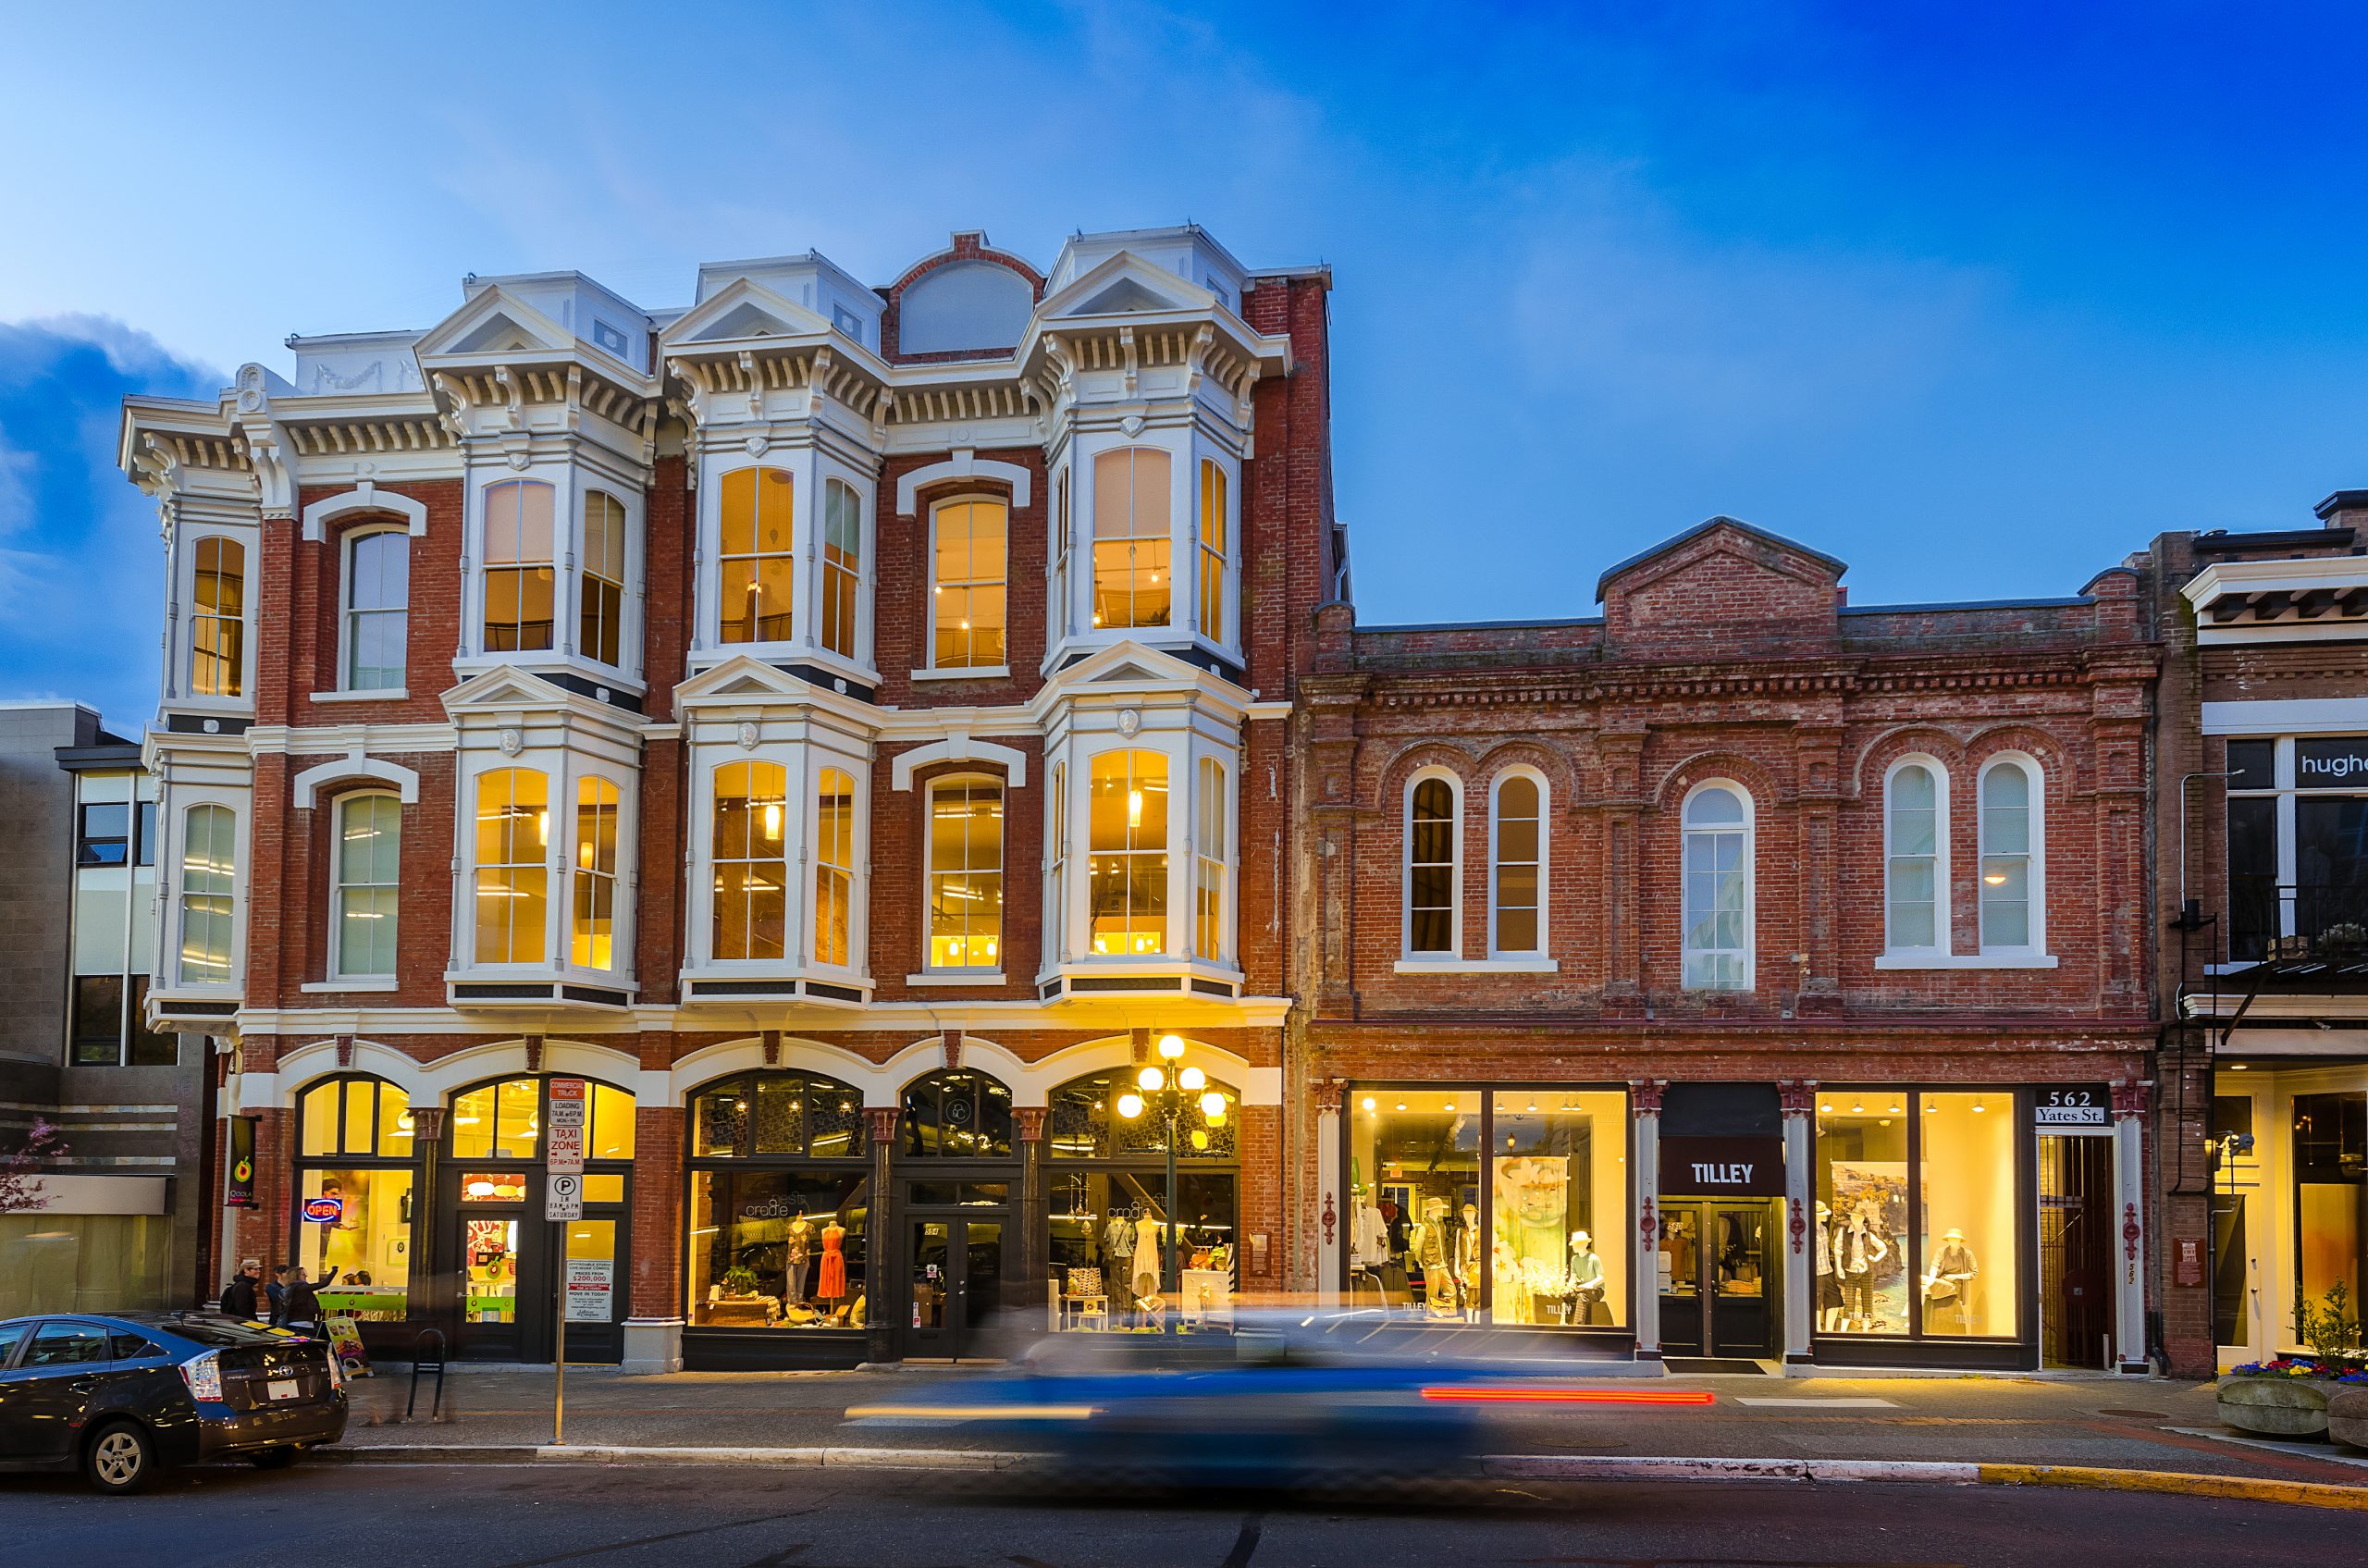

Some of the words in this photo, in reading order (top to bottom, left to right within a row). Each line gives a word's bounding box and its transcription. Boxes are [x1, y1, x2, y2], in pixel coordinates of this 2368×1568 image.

[2301, 754, 2368, 777] hugh
[2049, 1091, 2090, 1106] 562
[2038, 1108, 2078, 1121] Yates
[2081, 1108, 2103, 1121] St.
[555, 1129, 577, 1138] TAXI
[550, 1141, 580, 1150] ZONE
[1691, 1163, 1754, 1184] TILLEY
[561, 1179, 571, 1191] P
[307, 1204, 339, 1216] OPEN
[1401, 1302, 1426, 1312] TILLEY
